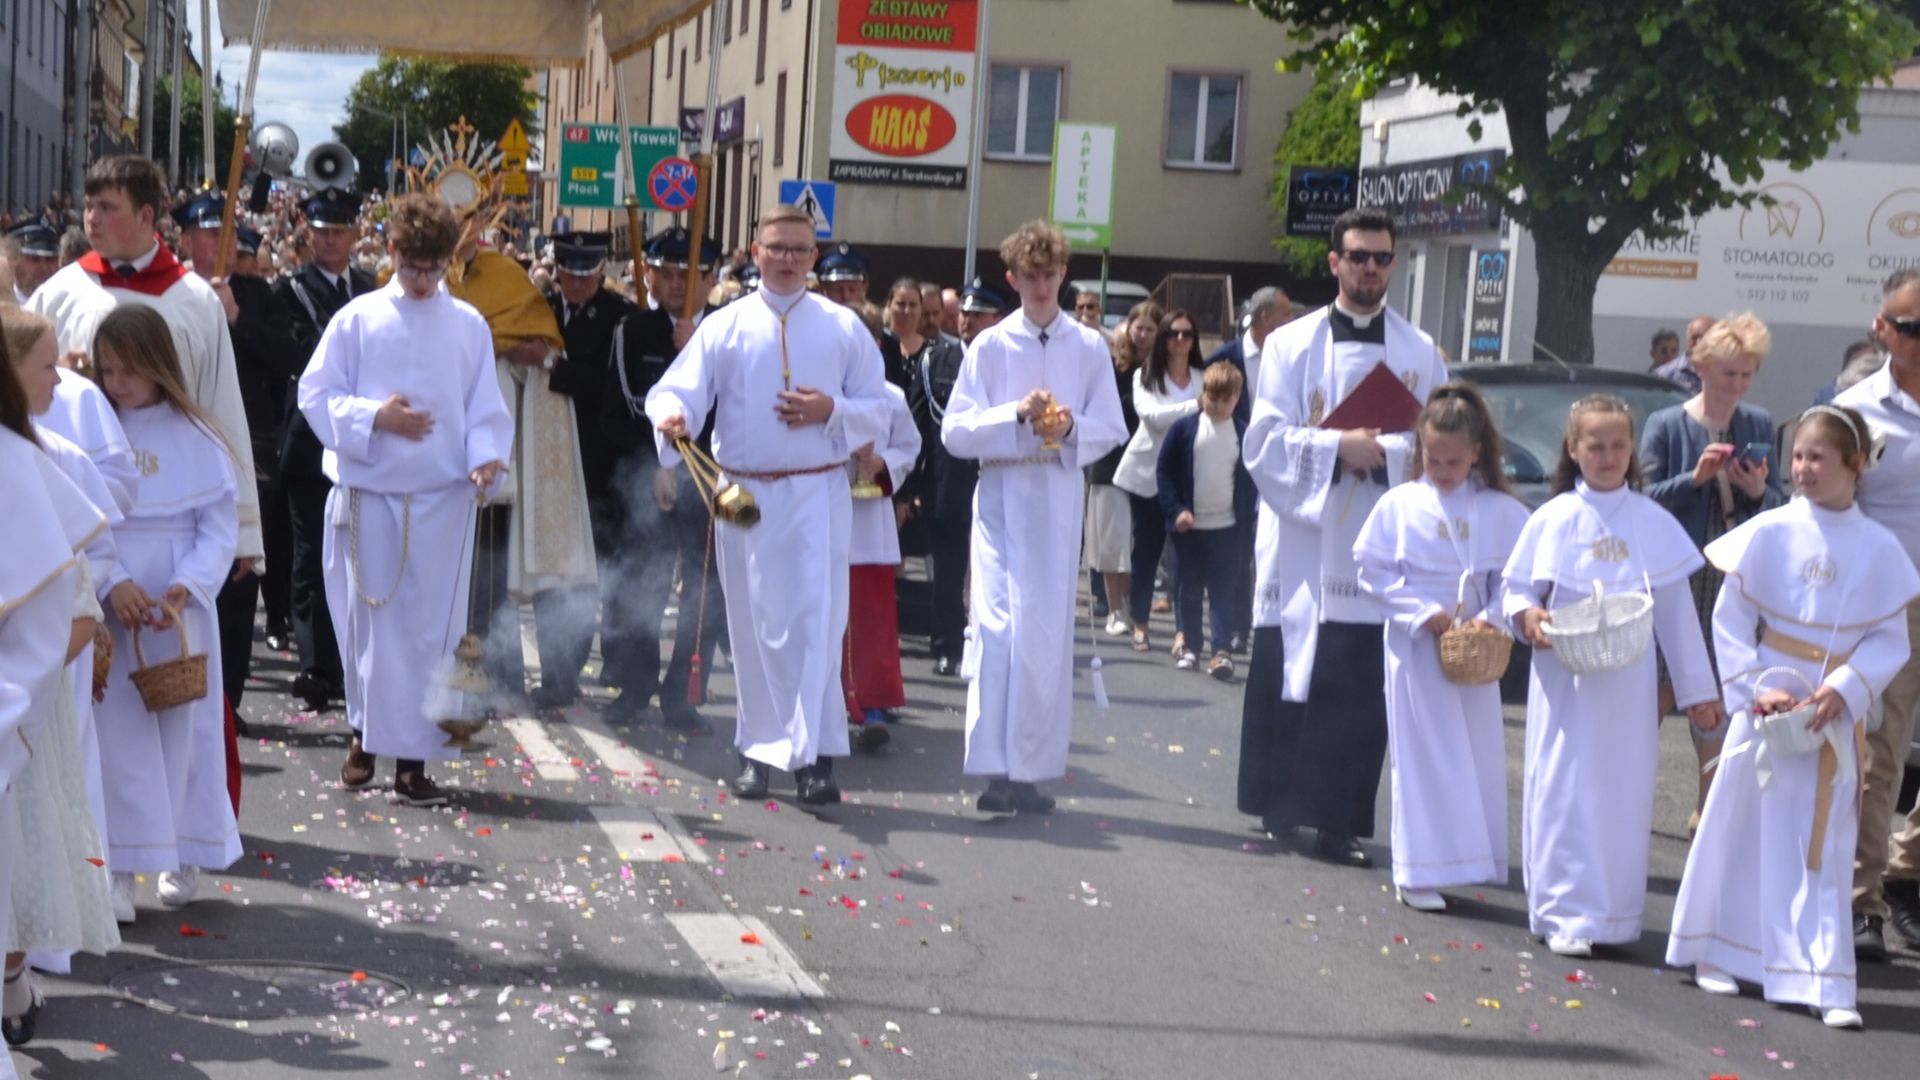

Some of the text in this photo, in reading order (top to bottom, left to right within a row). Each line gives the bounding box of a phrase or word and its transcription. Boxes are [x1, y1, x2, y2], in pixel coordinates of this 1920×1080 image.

[868, 0, 948, 19] ZESTAWY
[861, 22, 953, 43] OBIADOWE
[869, 104, 931, 150] HAOS
[595, 128, 677, 147] Włoławek
[833, 164, 891, 178] ZAPRASZAMY
[1076, 131, 1092, 219] APTEKA
[568, 182, 600, 195] Płock
[1298, 190, 1351, 203] OPTYK
[1361, 167, 1453, 207] SALON OPTYCZNY
[1722, 247, 1835, 268] STOMATOLOG
